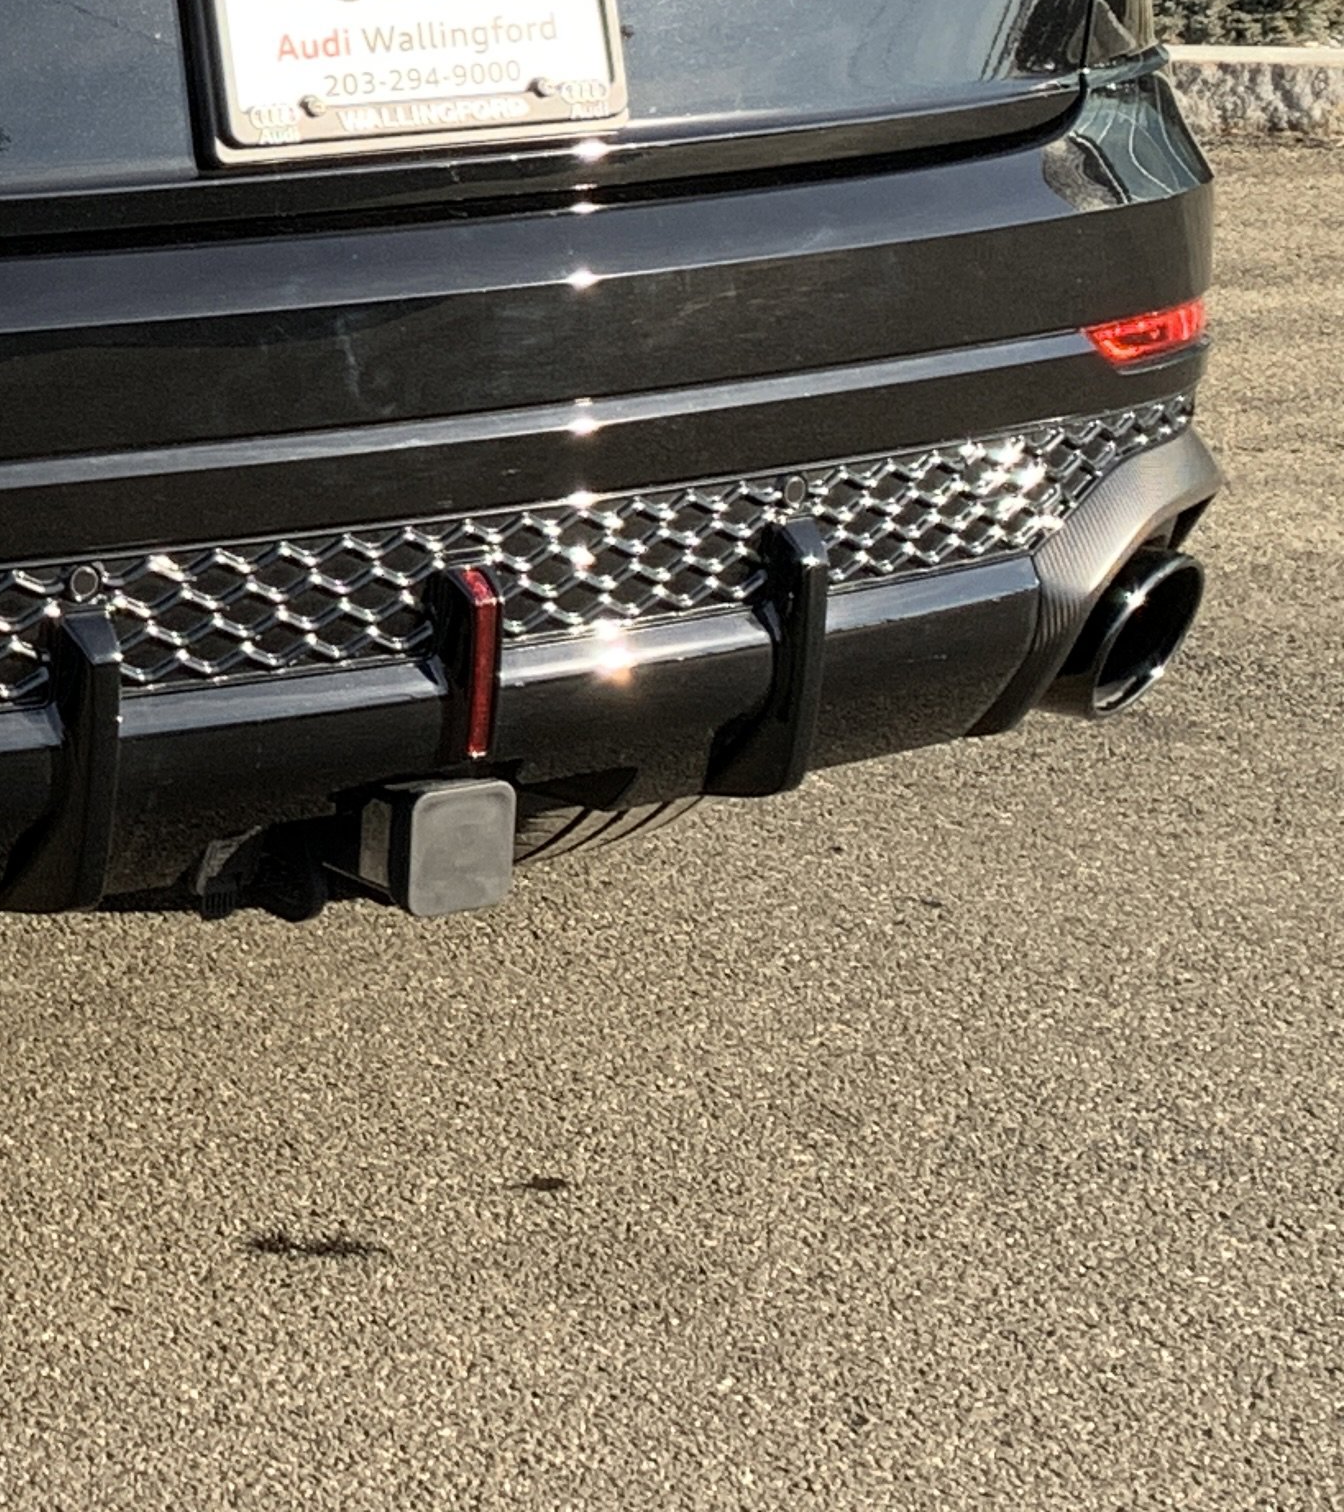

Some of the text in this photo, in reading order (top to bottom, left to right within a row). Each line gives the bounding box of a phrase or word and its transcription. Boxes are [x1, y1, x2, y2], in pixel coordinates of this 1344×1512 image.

[277, 12, 558, 62] Audi Wallingford
[323, 60, 522, 98] 203-294-9000
[336, 98, 530, 133] WALLINGFORD
